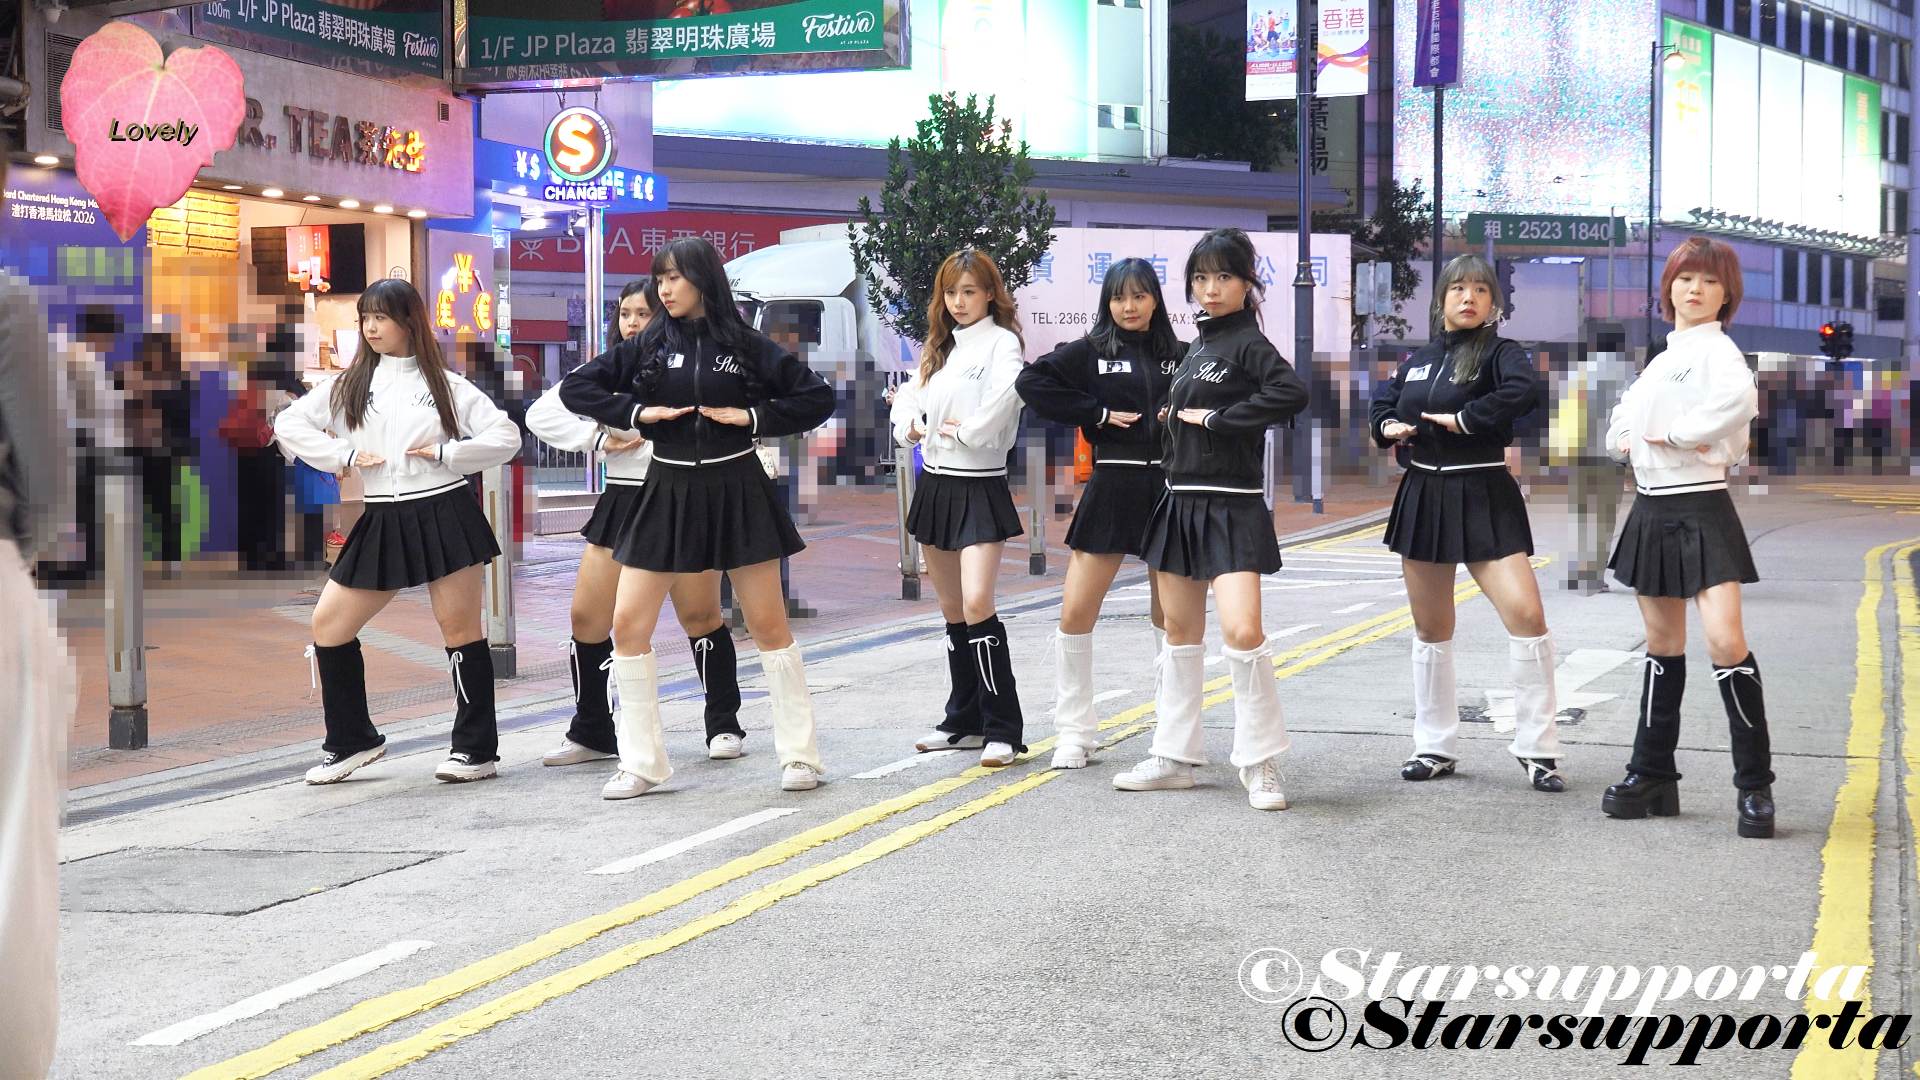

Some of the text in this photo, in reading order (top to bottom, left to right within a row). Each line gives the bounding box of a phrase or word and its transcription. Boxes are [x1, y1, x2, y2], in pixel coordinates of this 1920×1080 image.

[206, 2, 231, 20] 100m
[1323, 8, 1365, 30] 香港
[262, 0, 278, 24] JP
[281, 3, 315, 34] Plaza
[318, 11, 396, 57] 翡翠明珠廣場
[802, 10, 875, 44] Festiva
[402, 31, 440, 59] Festiva
[481, 22, 776, 61] 1/F JP Plaza 翡翠明珠廣場
[18, 190, 51, 204] Chartered
[51, 194, 69, 207] Hong
[69, 196, 87, 209] Kong
[544, 185, 609, 201] CHANGE
[73, 210, 96, 225] 2026
[1568, 222, 1610, 241] 1840
[712, 354, 741, 374] Slu
[1192, 361, 1228, 384] Slut
